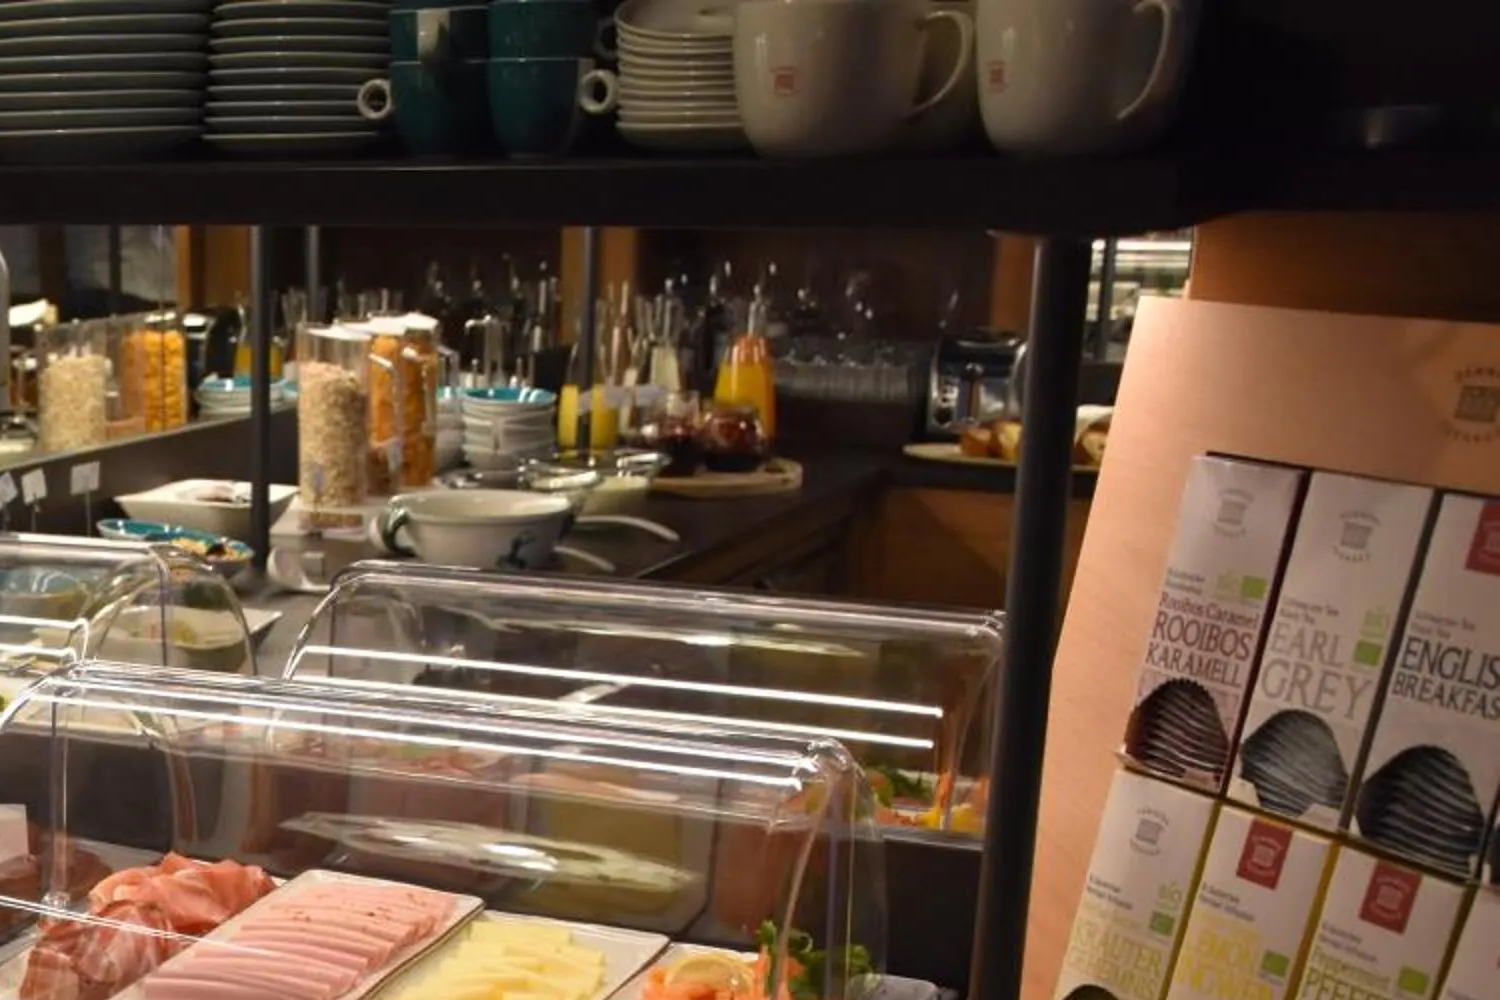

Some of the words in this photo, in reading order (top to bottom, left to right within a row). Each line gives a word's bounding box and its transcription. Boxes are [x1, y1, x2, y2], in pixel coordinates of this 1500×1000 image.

[1152, 610, 1254, 661] ROOIBOS
[1269, 621, 1344, 669] EARL
[1145, 643, 1242, 689] KARAMELL
[1261, 659, 1373, 721] GREY
